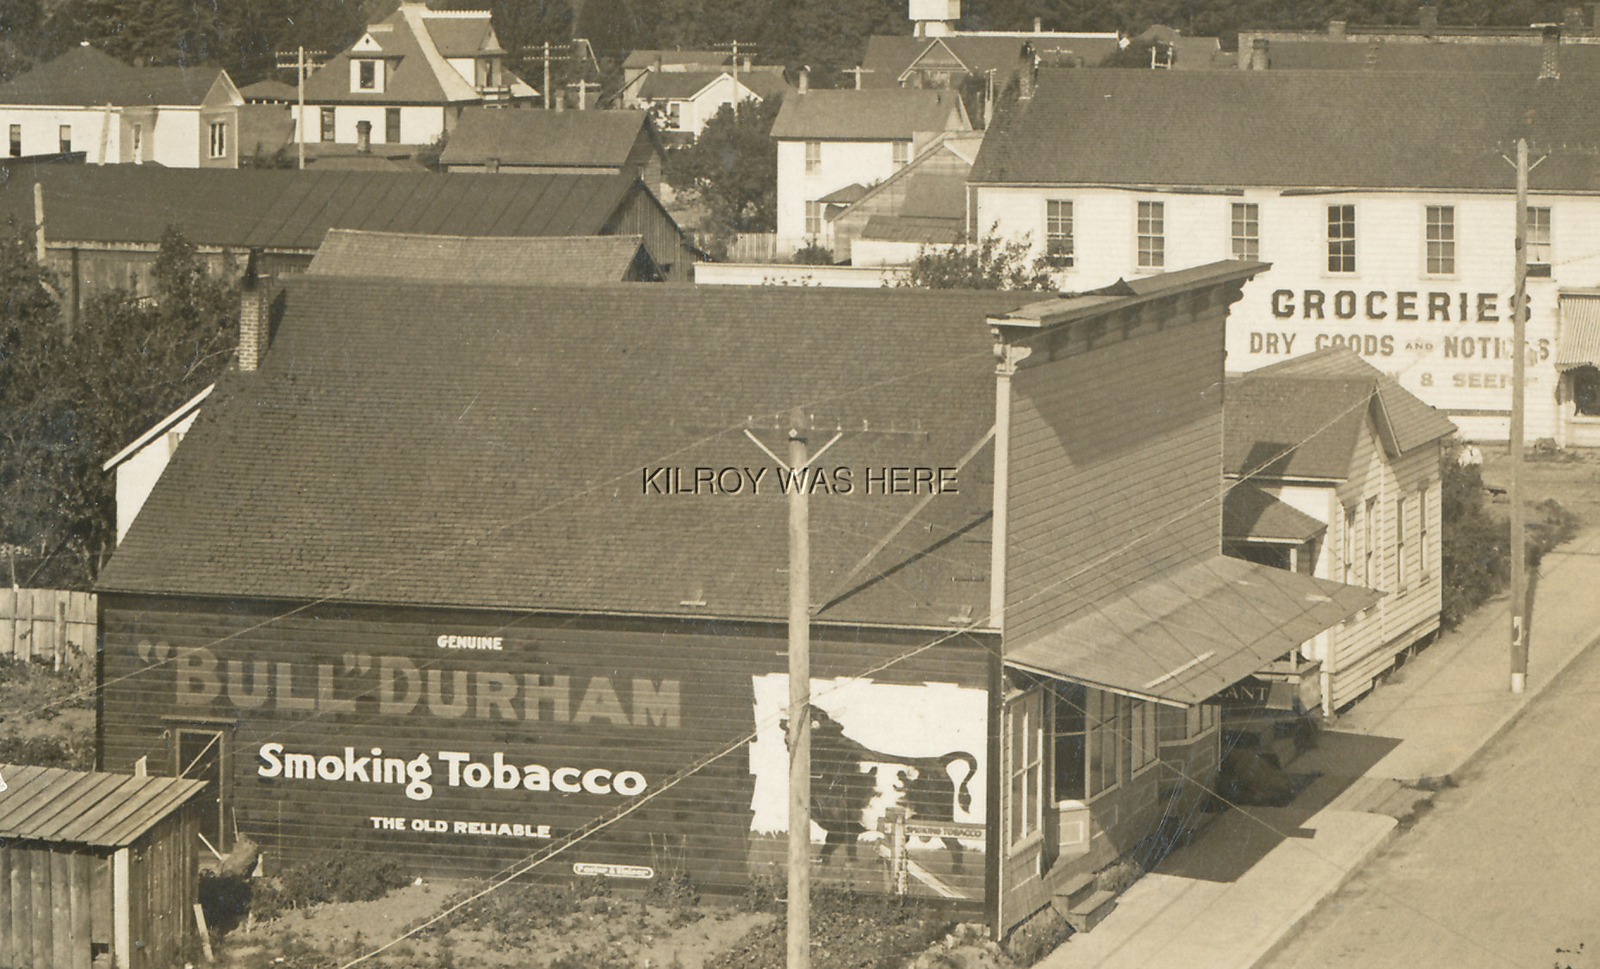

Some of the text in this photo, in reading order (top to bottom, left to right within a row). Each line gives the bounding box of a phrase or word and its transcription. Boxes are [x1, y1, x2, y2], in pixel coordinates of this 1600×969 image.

[1271, 288, 1532, 323] GROCERIES
[1249, 331, 1297, 355] DRY
[1405, 342, 1434, 351] AND
[1444, 335, 1550, 361] NOTIS
[436, 634, 504, 651] GENUINE
[378, 655, 681, 729] DURHAM
[257, 742, 648, 801] Smoking Tobacco
[370, 816, 552, 839] THE OLD RELIABLE
[943, 828, 983, 838] TOBACCO
